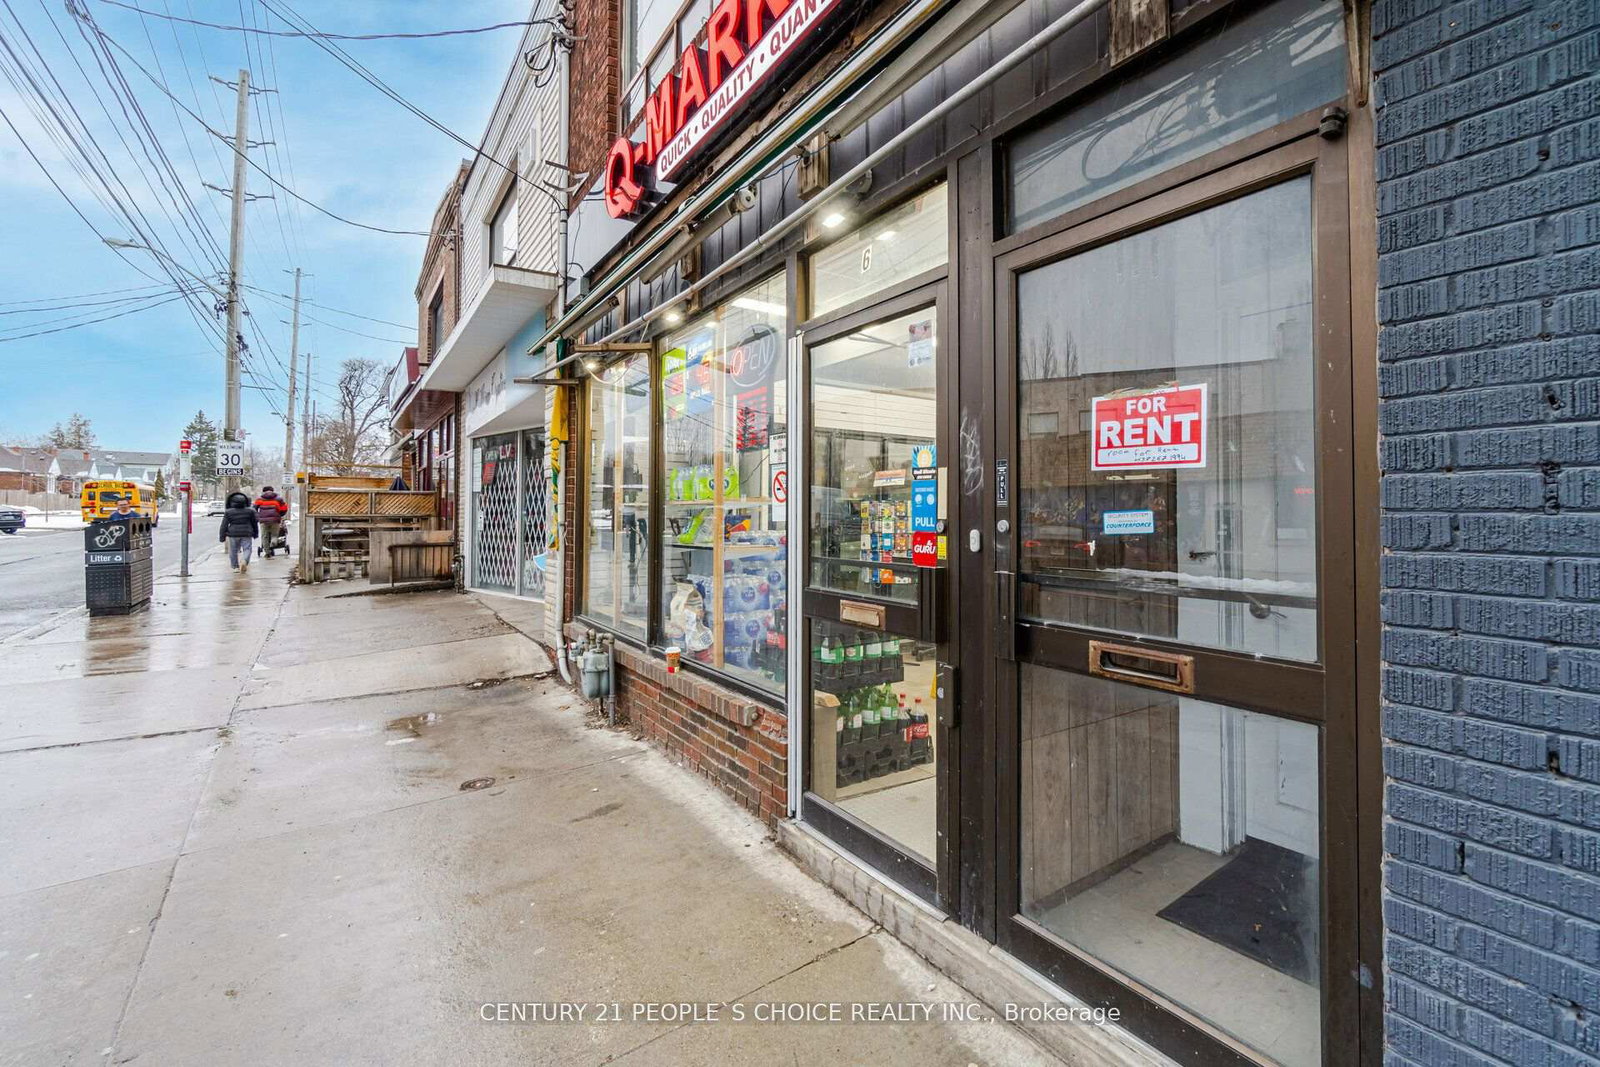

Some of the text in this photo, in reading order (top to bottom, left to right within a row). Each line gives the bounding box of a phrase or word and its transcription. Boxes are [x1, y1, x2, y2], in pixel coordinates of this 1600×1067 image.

[660, 0, 827, 173] QUICK QUALITY QUAN
[1127, 397, 1166, 415] FOR
[1099, 412, 1199, 448] RENT
[220, 453, 241, 466] 30
[915, 517, 935, 527] PULL
[914, 544, 936, 555] GURU
[90, 554, 111, 563] Litter
